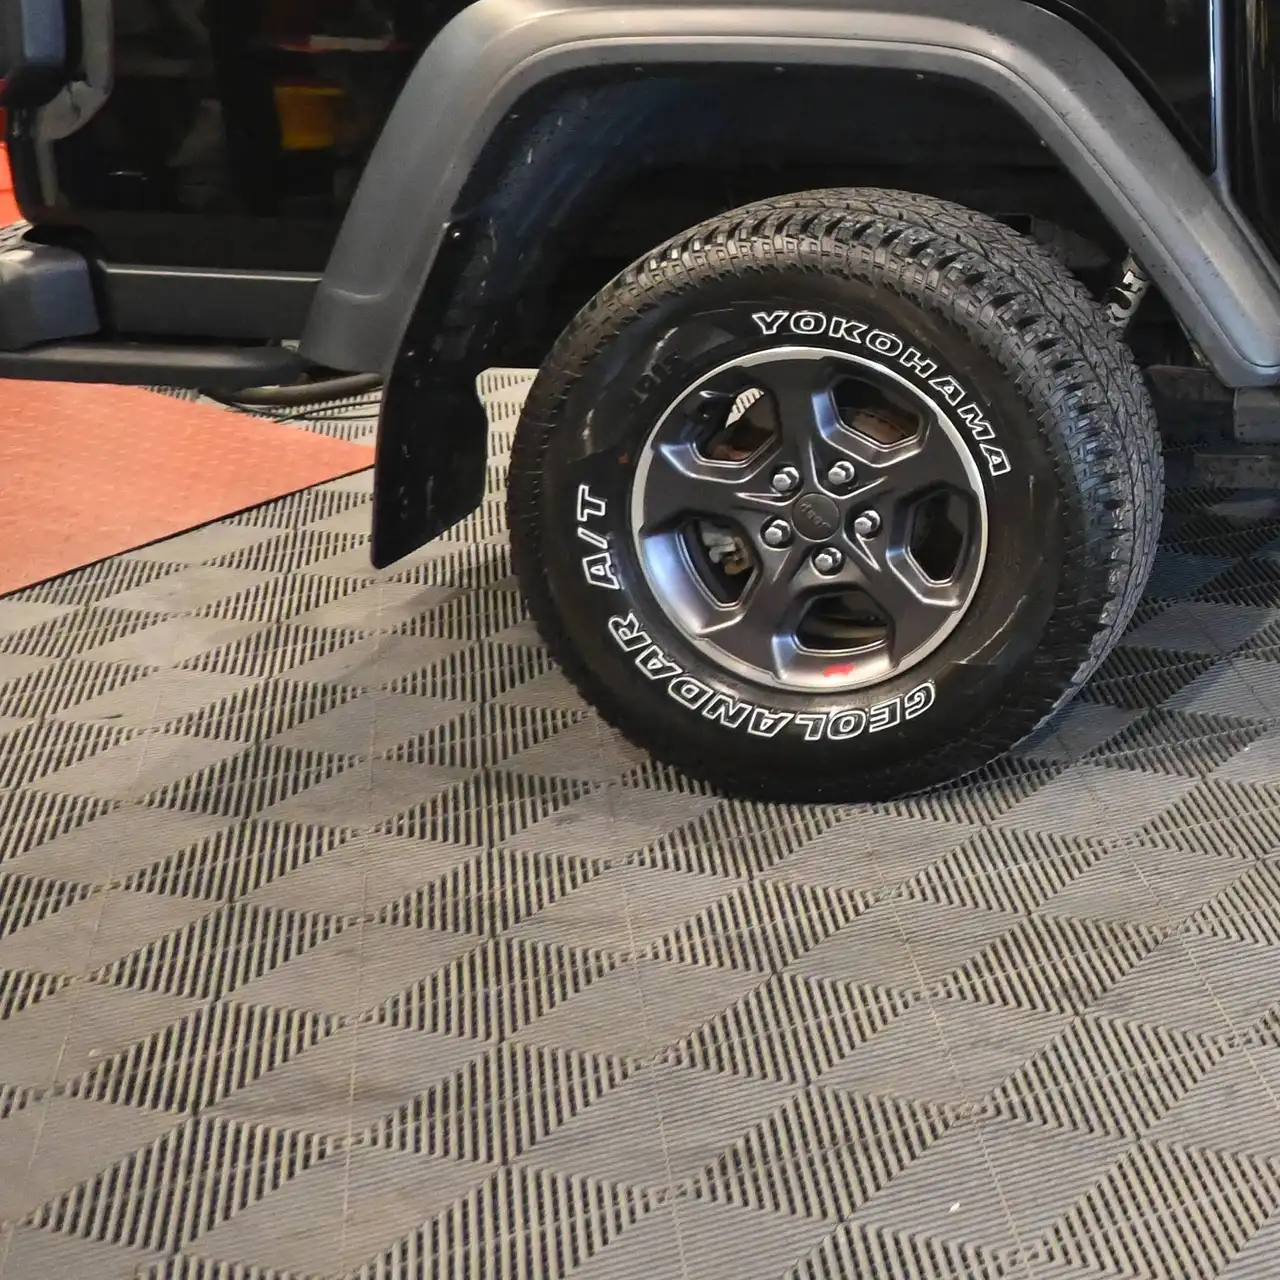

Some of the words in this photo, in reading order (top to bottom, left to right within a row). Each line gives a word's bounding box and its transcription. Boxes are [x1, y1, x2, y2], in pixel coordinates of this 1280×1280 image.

[750, 308, 1012, 477] YOKOHAMA
[577, 484, 621, 592] A/T
[607, 610, 937, 742] GEOLANDAR
